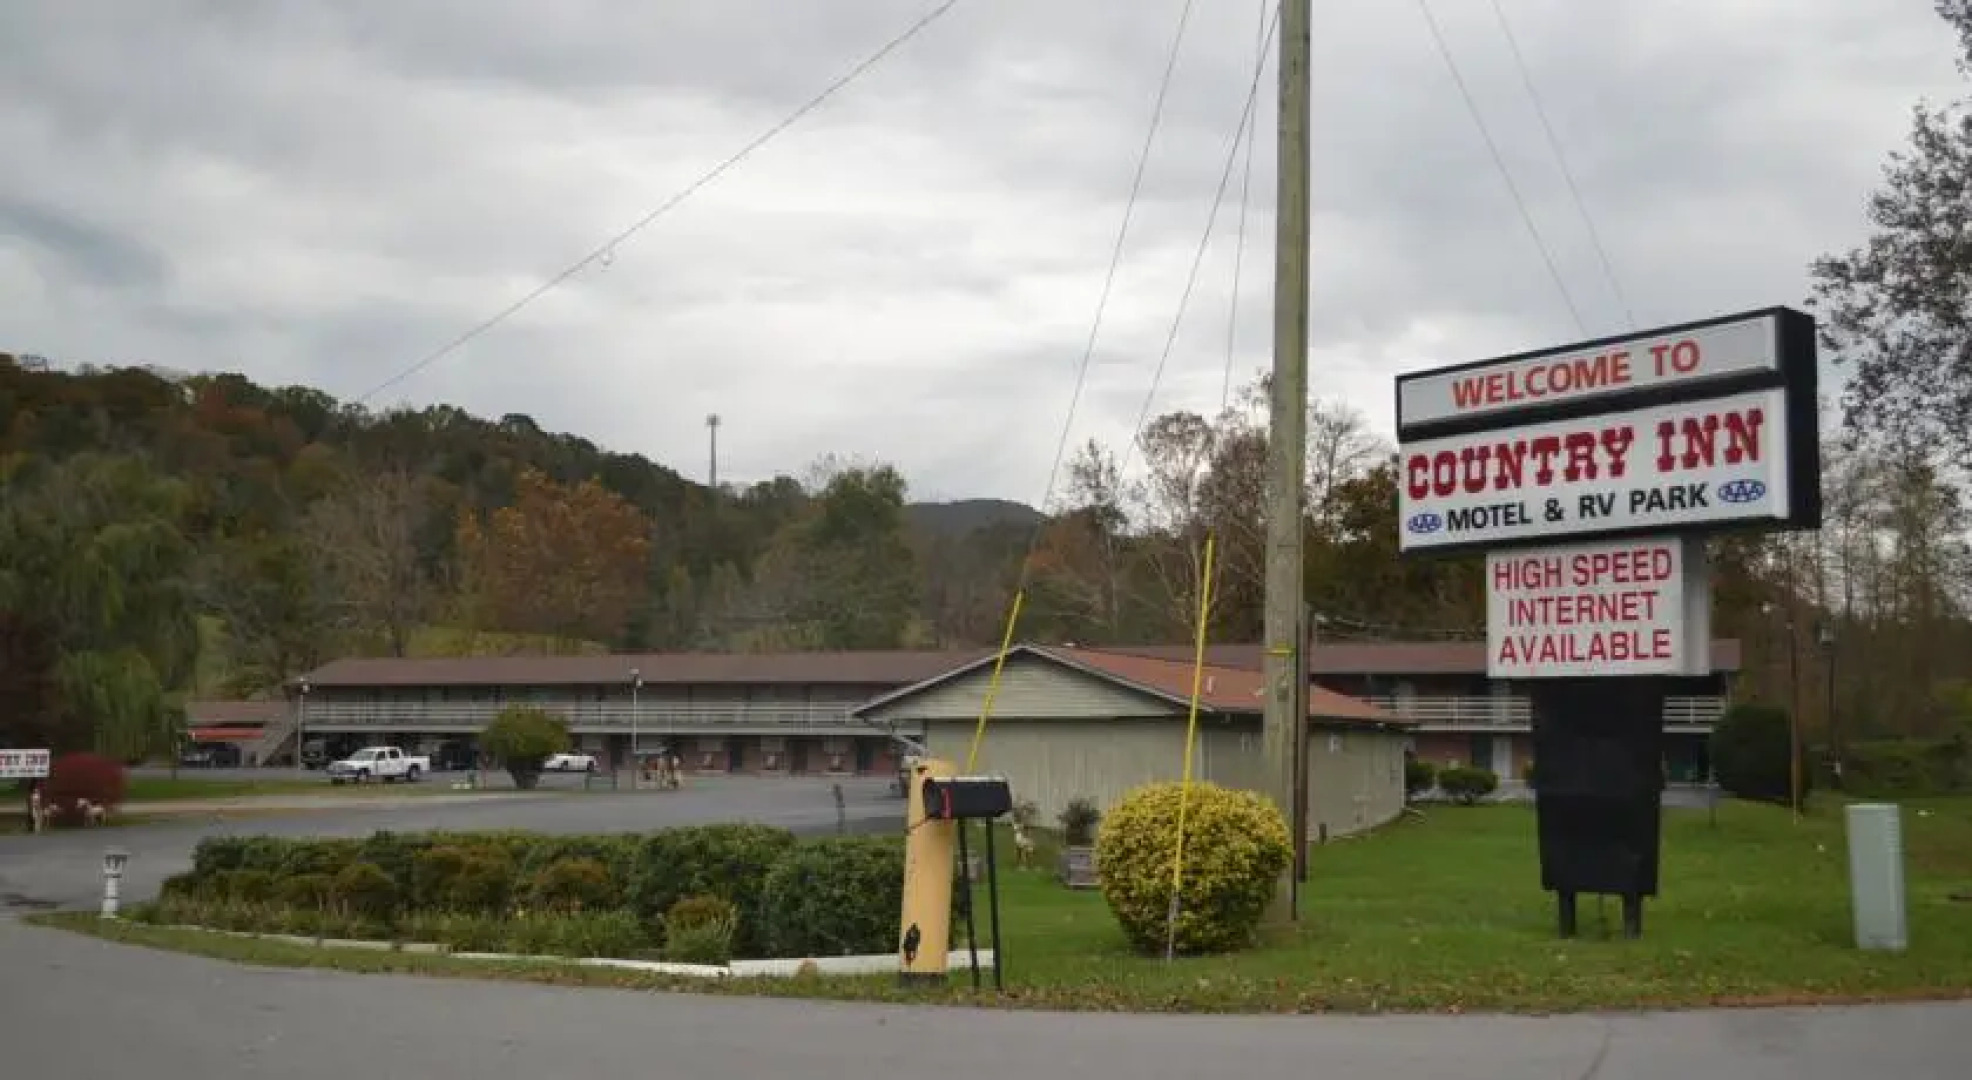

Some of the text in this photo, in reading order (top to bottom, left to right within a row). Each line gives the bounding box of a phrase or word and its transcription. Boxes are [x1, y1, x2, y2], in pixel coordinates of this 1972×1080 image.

[1453, 340, 1701, 408] WELCOME TO
[1407, 409, 1764, 499] COUNTRY INN
[1447, 503, 1532, 531] MOTEL
[1545, 498, 1563, 521] &
[1579, 493, 1615, 518] RV
[1629, 482, 1709, 514] PARK
[1494, 548, 1673, 590] HIGH SPEED
[1508, 591, 1659, 625] INTERNET
[1499, 629, 1672, 664] AVAILABLE
